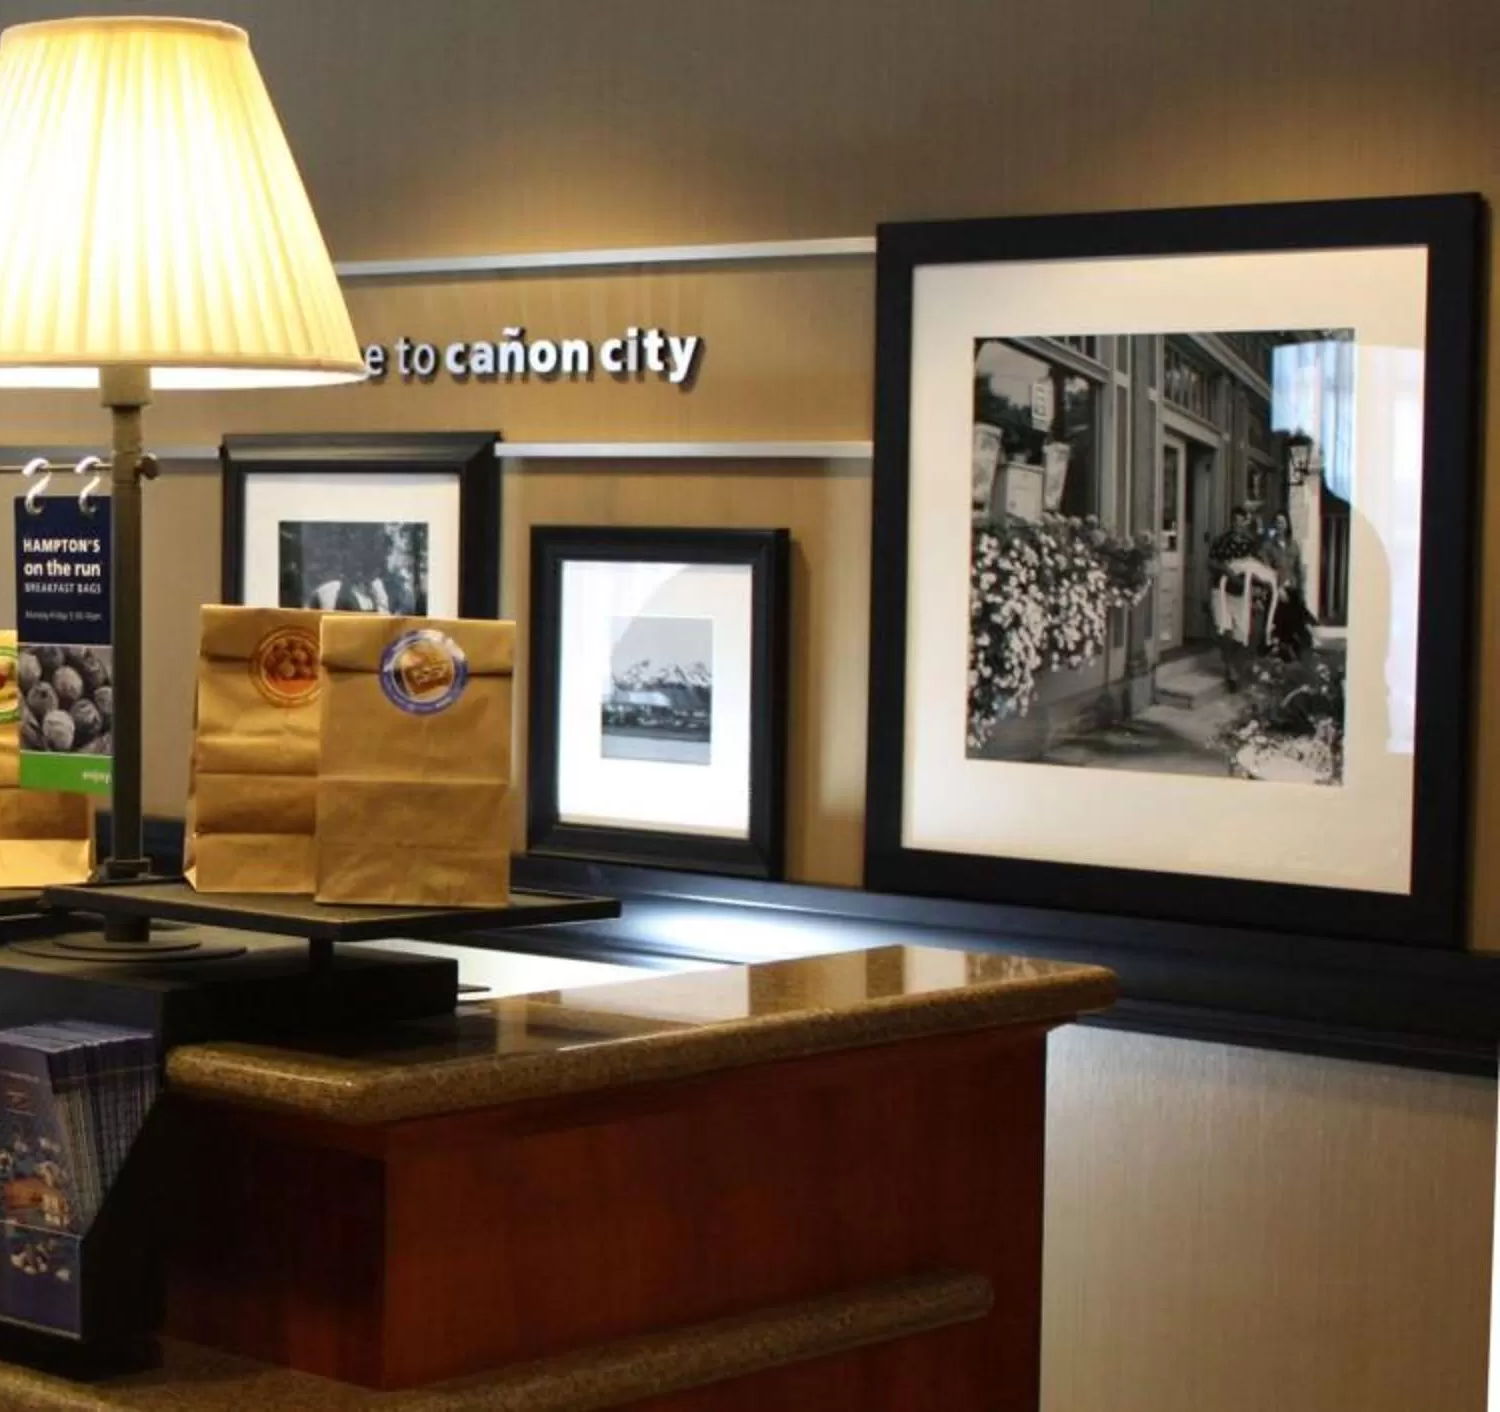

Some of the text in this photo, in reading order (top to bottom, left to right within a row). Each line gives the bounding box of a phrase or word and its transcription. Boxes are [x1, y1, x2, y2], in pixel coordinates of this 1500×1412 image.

[394, 337, 435, 375] to
[445, 326, 590, 374] cañon
[600, 327, 697, 383] city
[23, 538, 101, 553] HAMPTON'S
[23, 558, 101, 577] on the run
[24, 582, 101, 594] BREAKFAST BAGS
